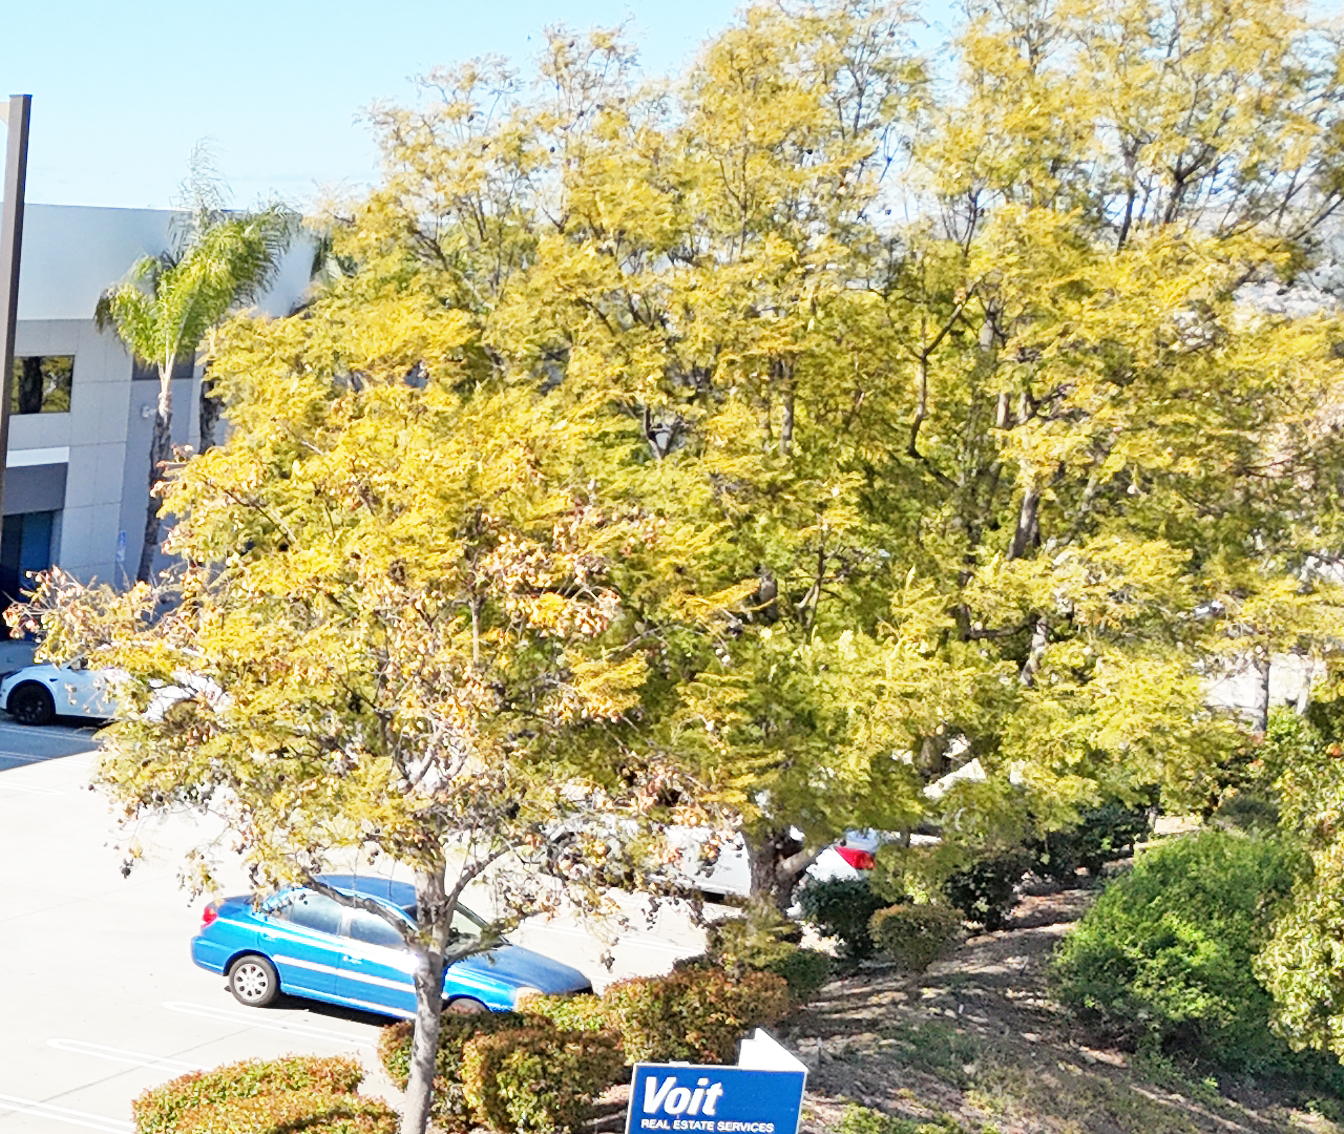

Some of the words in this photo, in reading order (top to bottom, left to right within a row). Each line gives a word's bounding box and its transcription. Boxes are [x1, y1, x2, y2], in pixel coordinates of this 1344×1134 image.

[642, 1076, 724, 1116] Voit
[640, 1118, 671, 1130] REAL
[673, 1119, 715, 1132] ESTATE
[717, 1121, 775, 1133] SERVICES
